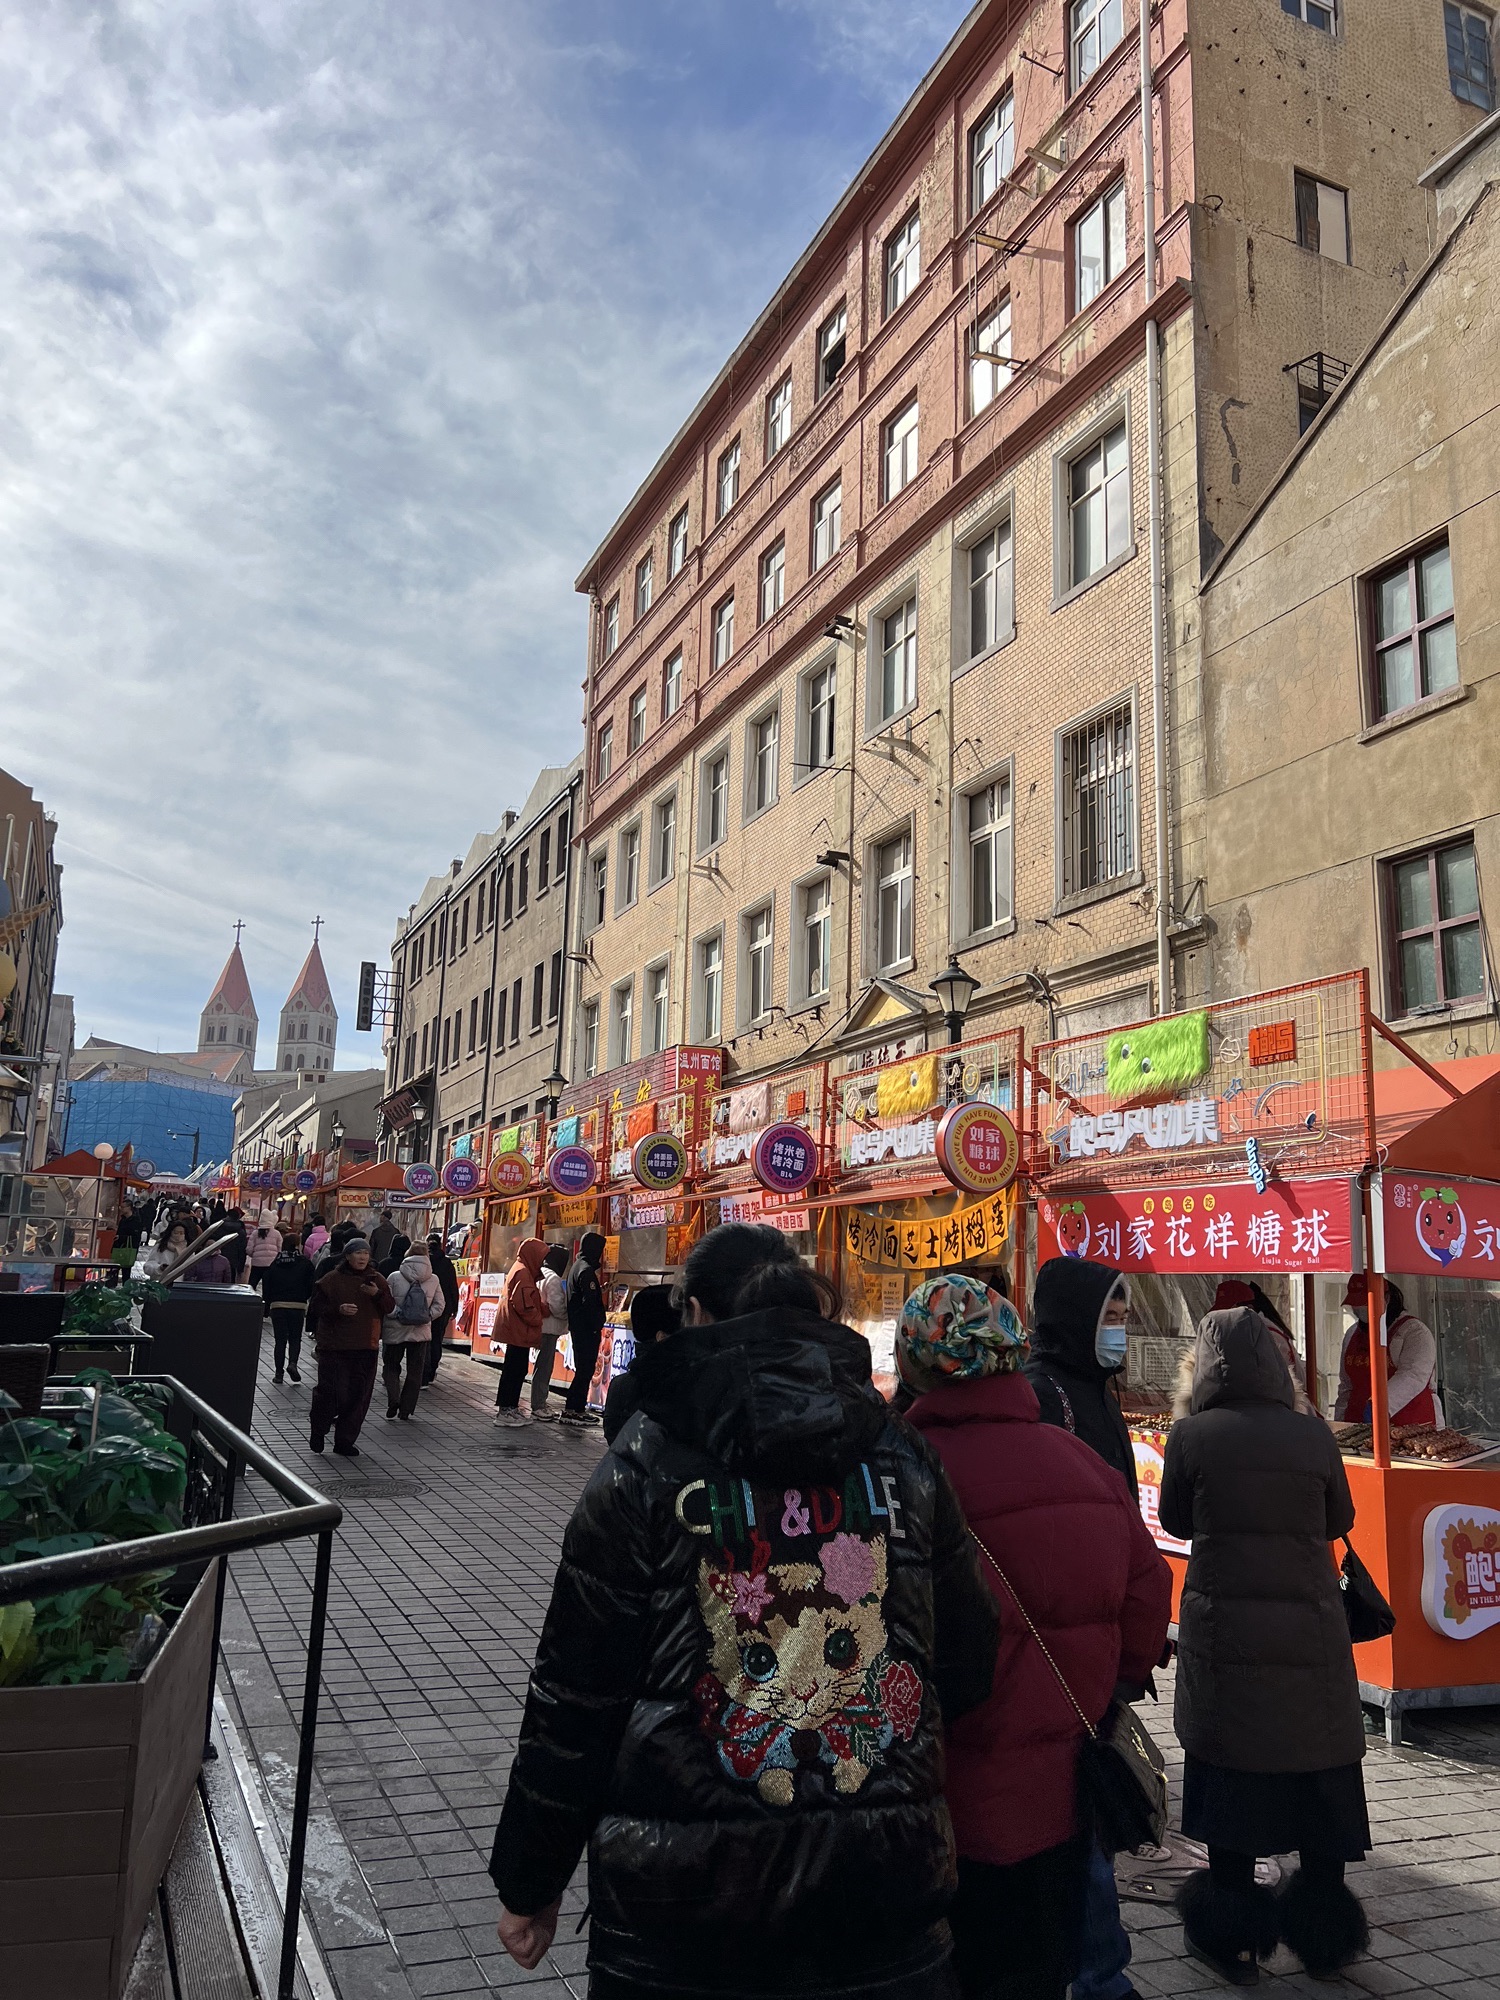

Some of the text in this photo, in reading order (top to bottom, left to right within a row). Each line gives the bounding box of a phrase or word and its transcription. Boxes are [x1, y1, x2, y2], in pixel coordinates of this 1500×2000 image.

[679, 1052, 721, 1072] 温州面馆
[969, 1126, 1000, 1144] 刘家
[1070, 1096, 1218, 1158] 鲍岛风物集
[850, 1114, 935, 1165] 鲍岛风物集
[969, 1144, 1000, 1161] 糖球
[772, 1154, 804, 1172] 烤冷面
[979, 1162, 991, 1170] B4
[1144, 1193, 1215, 1213] 青岛名吃
[848, 1196, 1006, 1264] 烤冷面芝士烤榴莲
[1093, 1208, 1333, 1260] 刘家花样糖球
[1261, 1256, 1320, 1268] LiuJia Sugar Ball
[675, 1463, 906, 1548] CHI & DALE
[1465, 1550, 1500, 1594] 鲍
[1469, 1597, 1479, 1605] IN
[1479, 1595, 1495, 1604] THE
